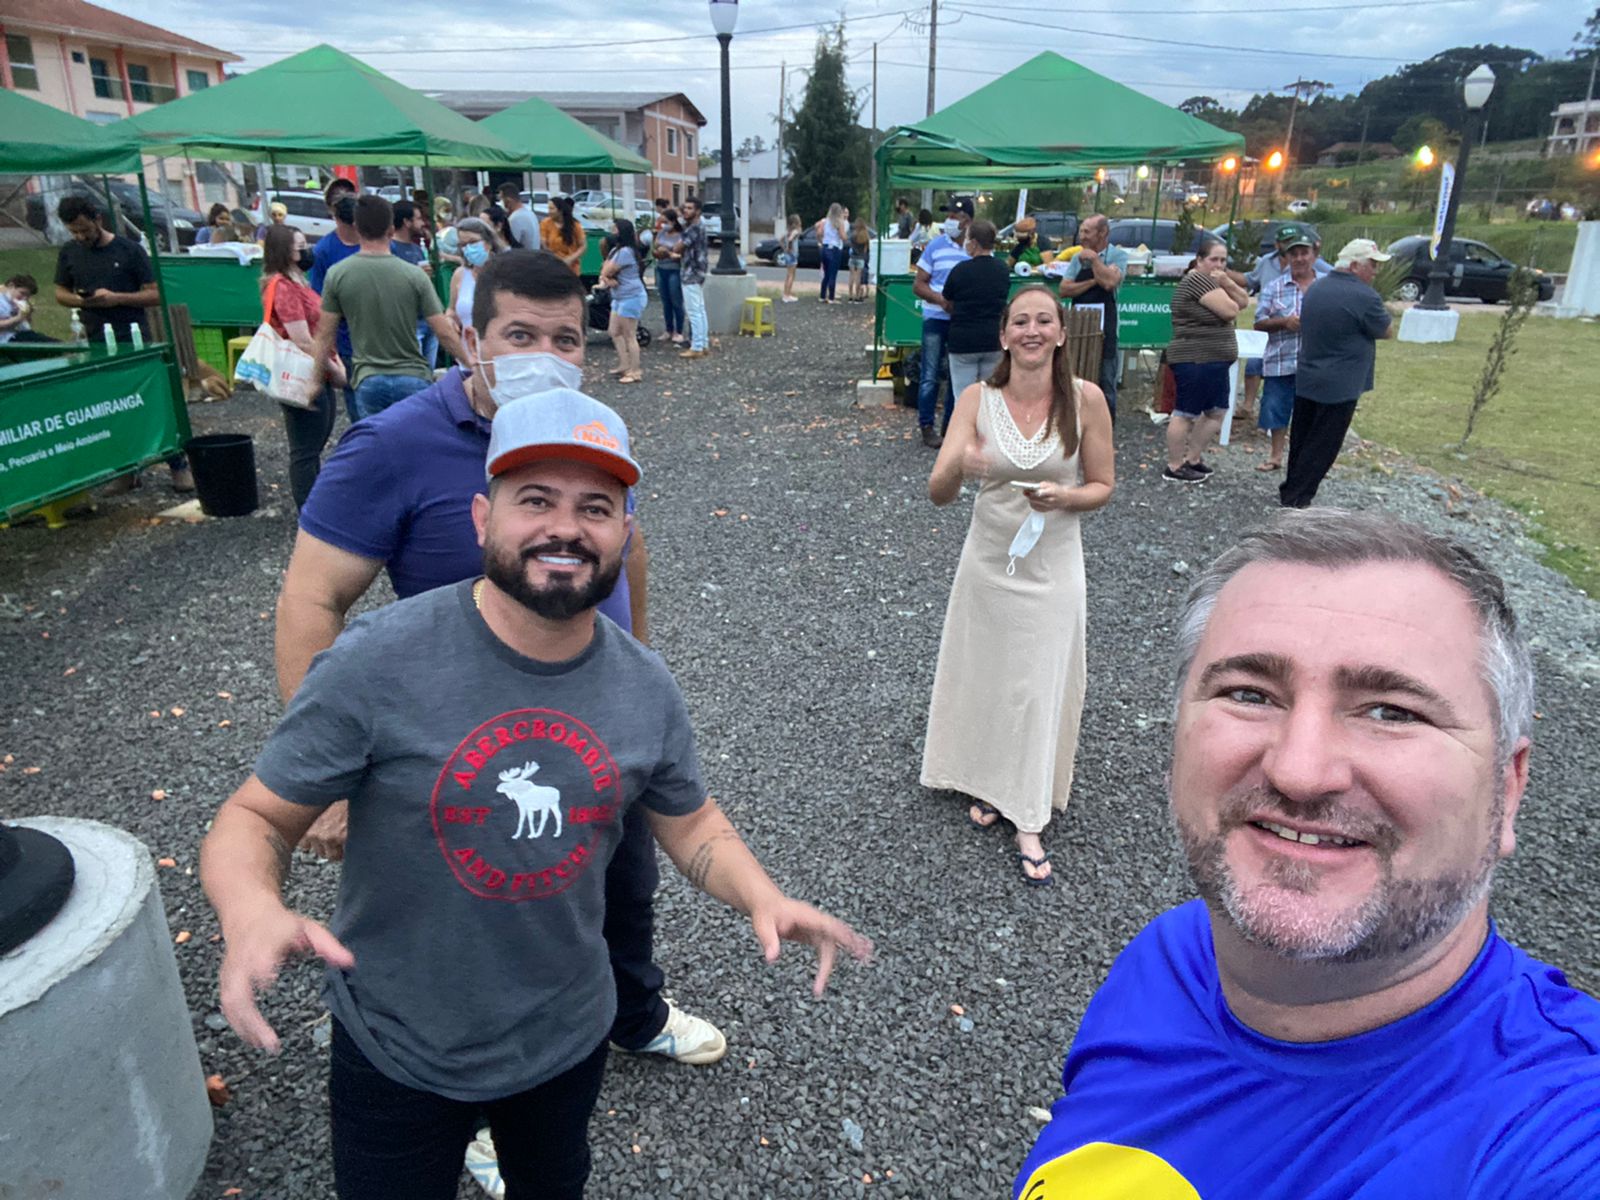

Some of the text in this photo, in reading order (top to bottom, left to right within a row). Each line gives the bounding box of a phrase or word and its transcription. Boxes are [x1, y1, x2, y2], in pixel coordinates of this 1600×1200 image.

[44, 415, 64, 433] DE
[65, 393, 144, 426] GUAMIRANGA
[54, 441, 75, 453] Meio
[75, 429, 111, 447] Ambiente
[453, 719, 613, 793] ABERCROMBIE
[443, 806, 492, 826] EST
[453, 843, 589, 892] AND FITCH
